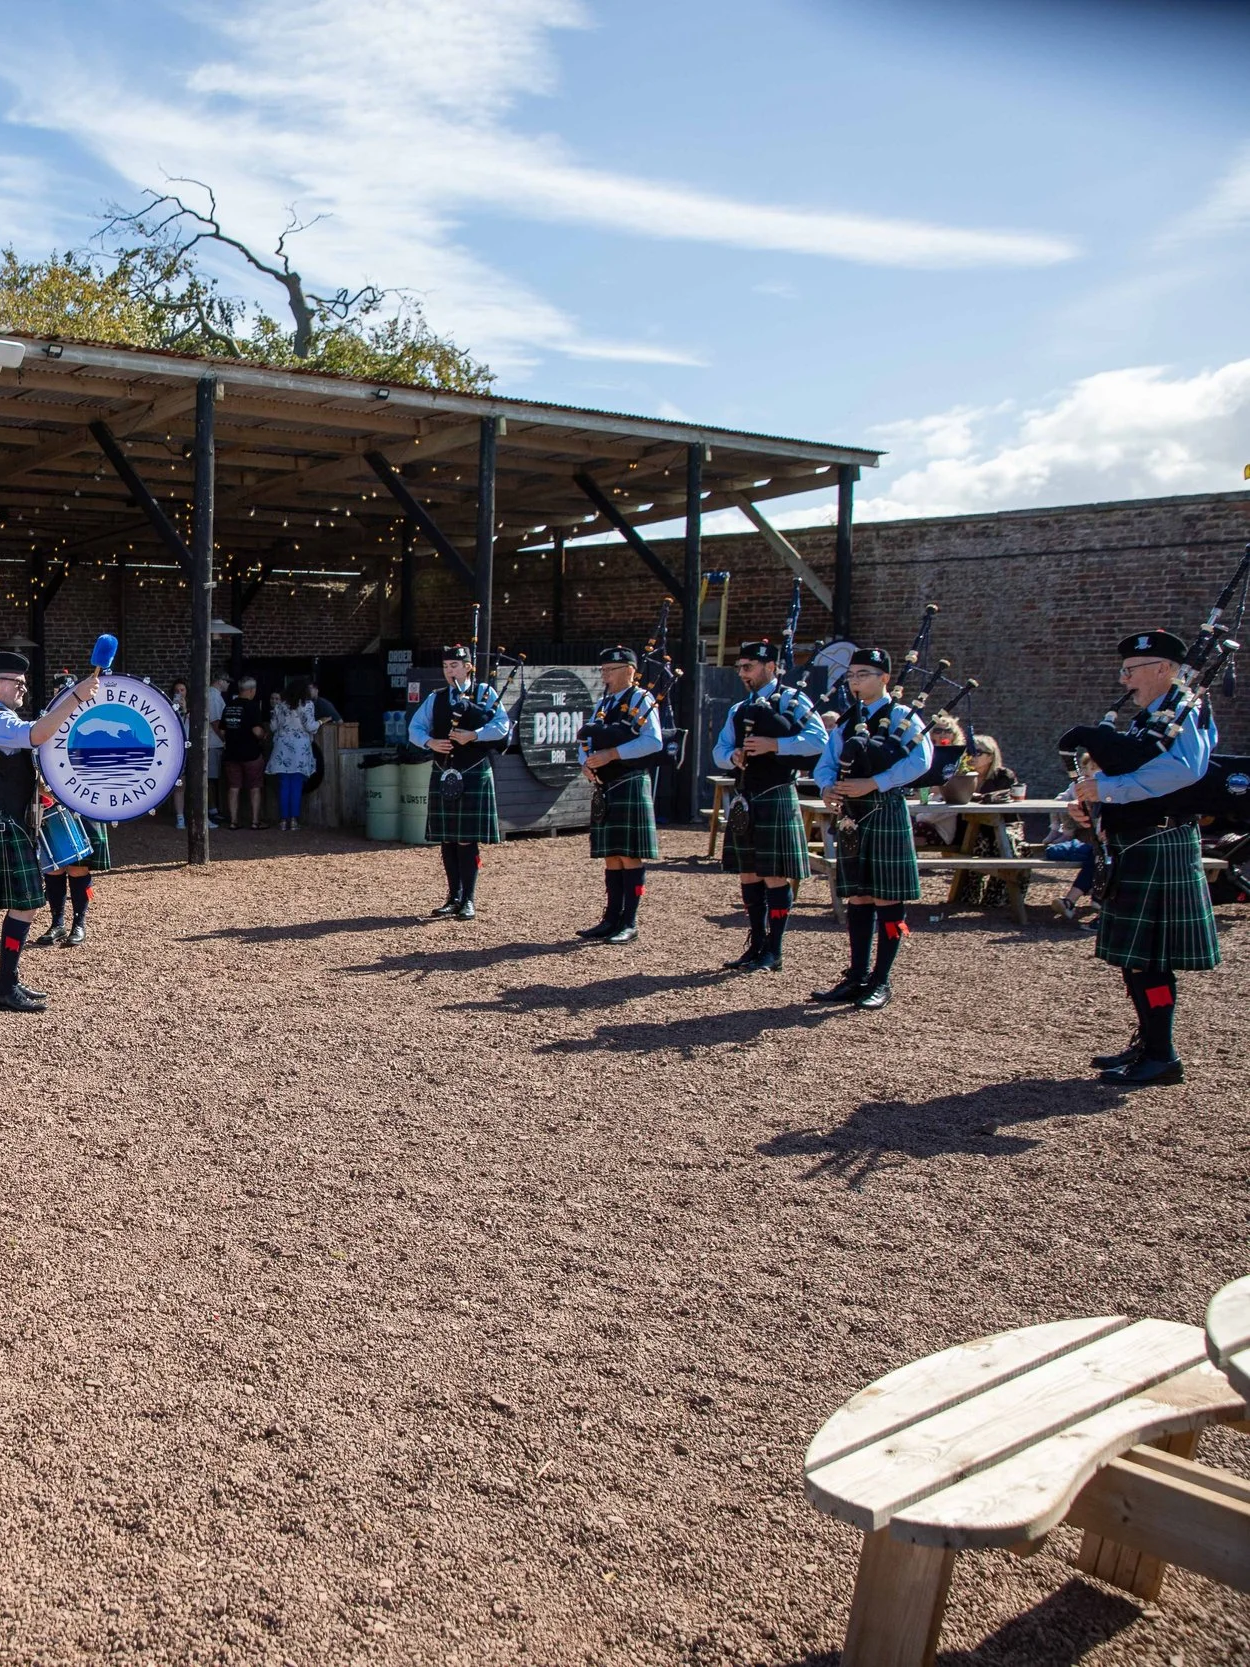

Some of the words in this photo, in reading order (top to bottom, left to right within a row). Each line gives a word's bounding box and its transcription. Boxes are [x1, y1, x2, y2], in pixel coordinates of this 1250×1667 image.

[552, 692, 566, 706] THE
[106, 689, 169, 748] BERWICK
[534, 711, 584, 744] BARN
[551, 750, 566, 763] BAR
[65, 776, 100, 805] PIPE
[110, 777, 156, 807] BAND
